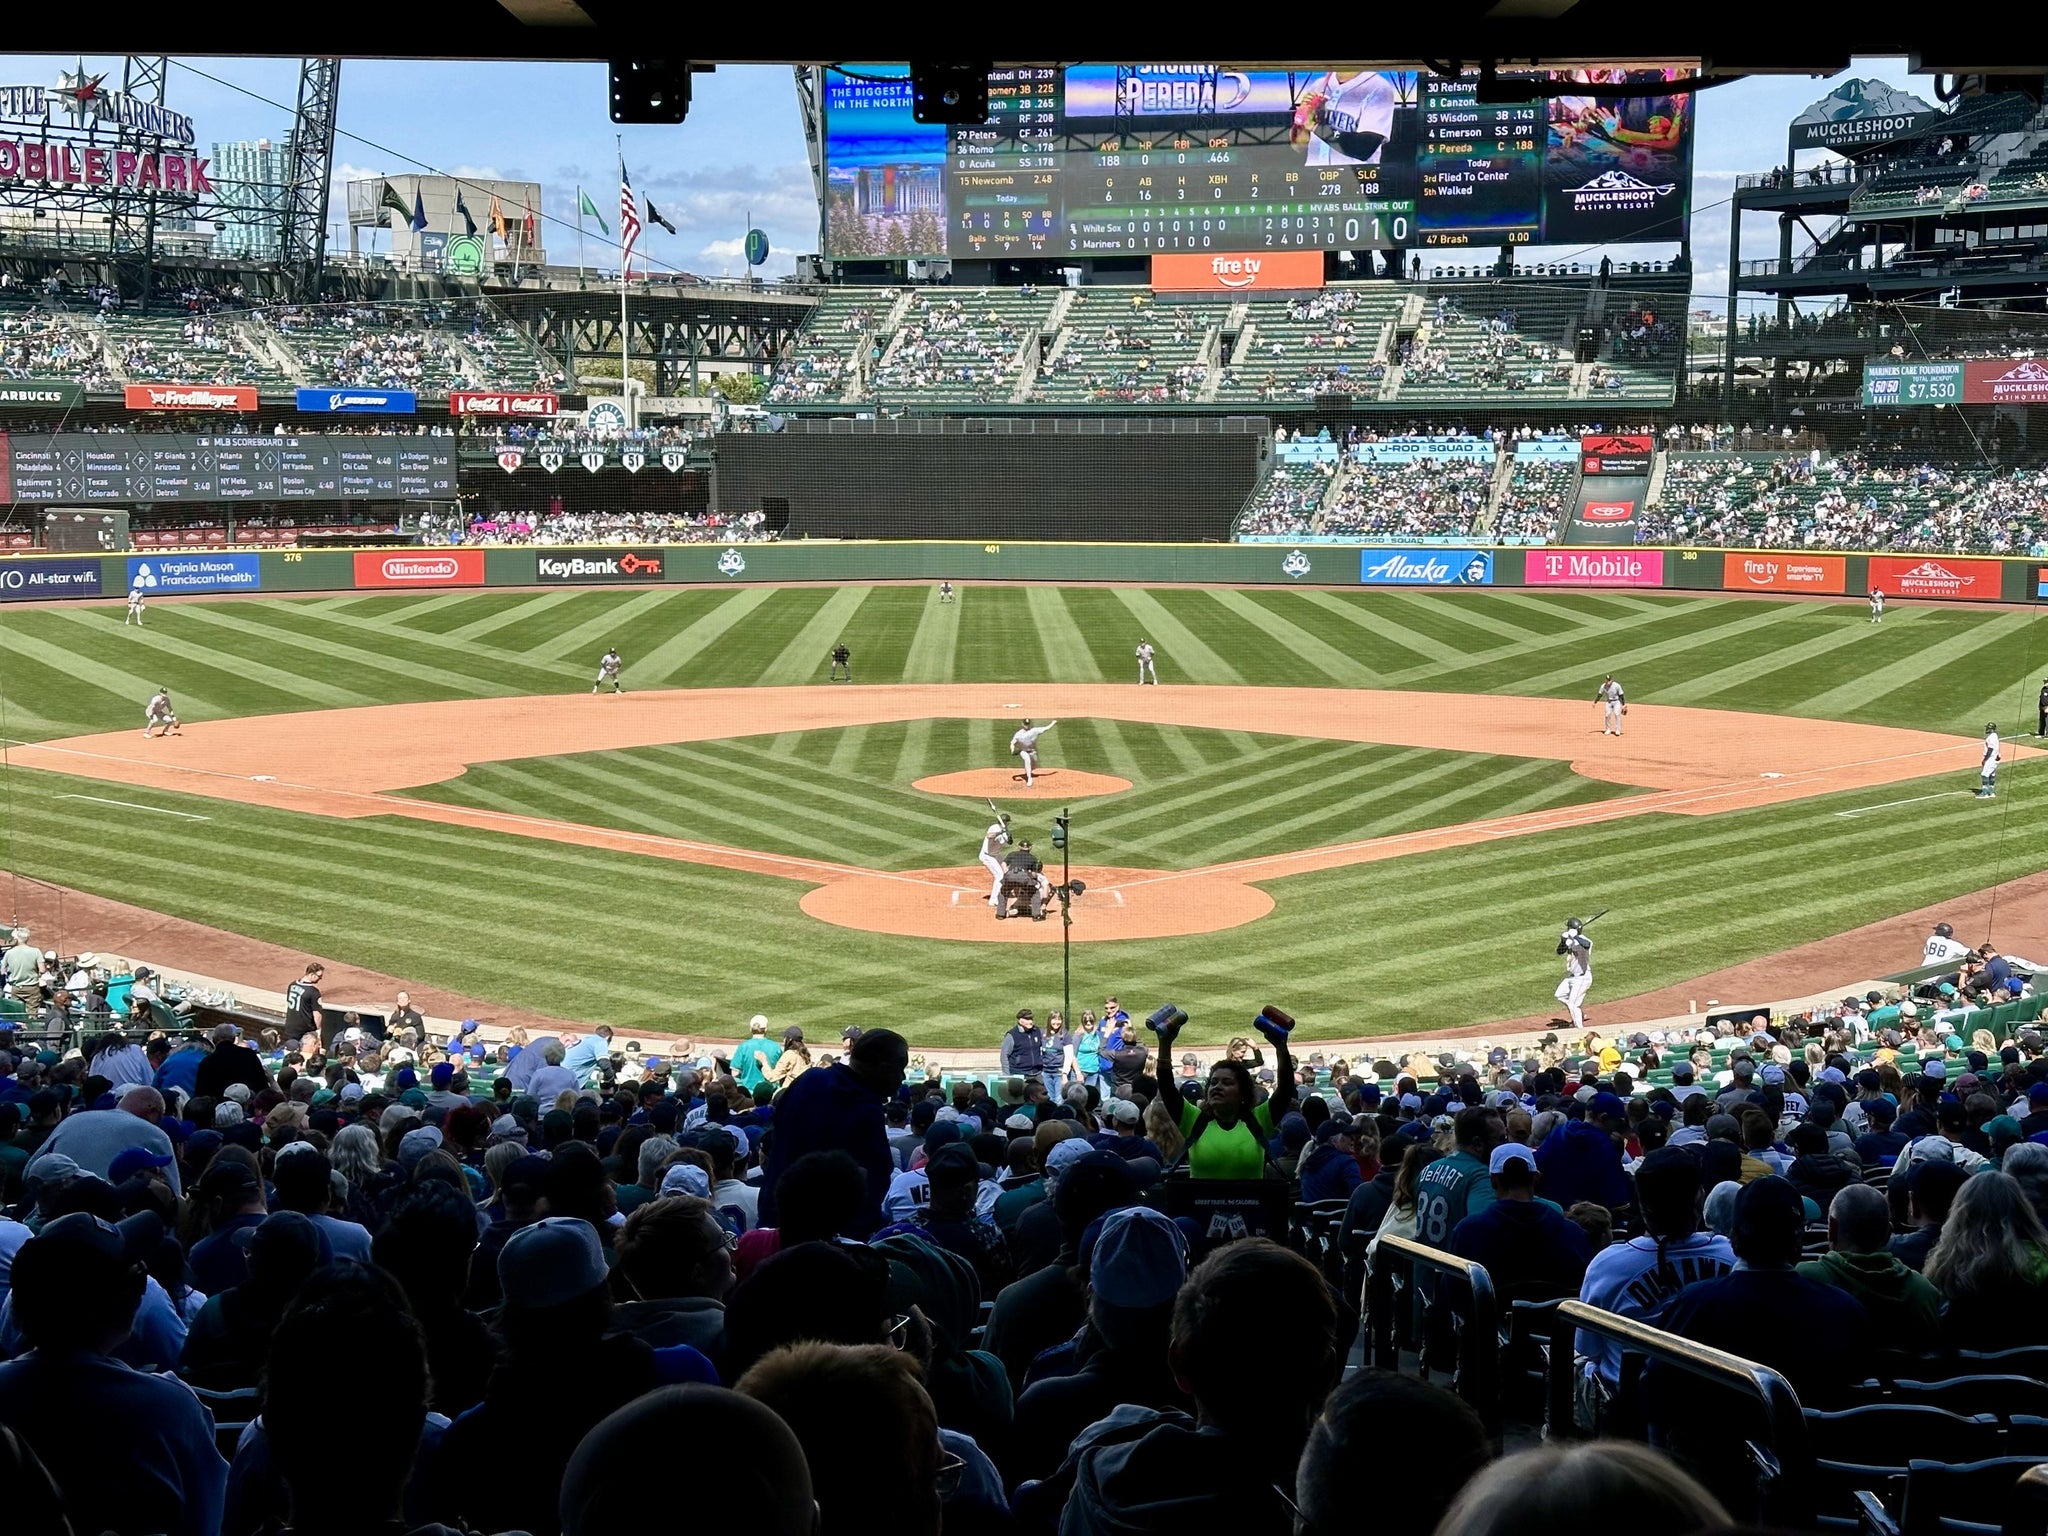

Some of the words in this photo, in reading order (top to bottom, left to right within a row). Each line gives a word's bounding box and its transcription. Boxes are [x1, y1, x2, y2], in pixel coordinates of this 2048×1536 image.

[1034, 70, 1054, 80] .239
[832, 88, 852, 98] THE
[854, 86, 902, 97] BIGGEST
[904, 86, 913, 95] &
[1034, 84, 1054, 94] .225
[1126, 77, 1216, 112] PEREDA
[1428, 84, 1438, 93] 30
[834, 100, 846, 110] IN
[849, 99, 869, 109] THE
[872, 97, 914, 108] NORTH
[1034, 99, 1054, 108] .265
[1440, 98, 1480, 107] Canzon
[100, 88, 195, 145] MARINERS
[1034, 114, 1054, 123] .208
[1426, 114, 1438, 124] 35
[1440, 112, 1478, 122] Wisdom
[1496, 110, 1508, 120] 3B
[1513, 110, 1534, 120] .143
[1440, 128, 1482, 138] Emerson
[1494, 126, 1508, 136] SS
[1512, 125, 1532, 135] .091
[1806, 116, 1916, 138] MUCKLESHOOT
[969, 130, 998, 140] Peters
[1034, 128, 1054, 138] .261
[1826, 136, 1861, 145] INDIAN
[1865, 131, 1894, 141] TRIBE
[969, 144, 994, 154] Romo
[1034, 143, 1054, 152] .178
[1100, 142, 1120, 152] AVG
[1174, 140, 1190, 149] RBI
[1208, 138, 1228, 148] OPS
[1440, 144, 1472, 153] Pereda
[1512, 140, 1534, 150] .188
[969, 160, 996, 168] Acuña
[1034, 158, 1054, 167] .178
[1098, 155, 1120, 166] .188
[1208, 152, 1230, 163] .466
[1467, 159, 1492, 168] Today
[0, 140, 108, 186] OBILE
[115, 150, 214, 194] PARK
[972, 175, 1014, 186] Newcomb
[1034, 174, 1053, 184] 2.48
[1320, 172, 1340, 180] OBP
[1357, 170, 1377, 180] SLG
[1424, 174, 1437, 183] 3rd
[1438, 172, 1462, 182] Flied
[1463, 172, 1476, 182] To
[1477, 172, 1510, 180] Center
[1318, 184, 1342, 196] .278
[1356, 183, 1380, 195] .188
[1424, 188, 1436, 196] 5th
[1438, 186, 1473, 196] Walked
[1574, 191, 1656, 204] MUCKLESHOOT
[1342, 202, 1363, 211] BALL
[1364, 202, 1389, 210] STRIKE
[1392, 202, 1408, 210] OUT
[1574, 203, 1612, 211] CASINO
[1616, 202, 1655, 210] RESORT
[1082, 224, 1105, 233] White
[1106, 224, 1122, 233] Sox
[1346, 218, 1358, 241] 0
[1370, 218, 1379, 240] 1
[1394, 216, 1407, 240] 0
[1082, 239, 1120, 248] Mariners
[1426, 235, 1438, 244] 47
[1440, 234, 1468, 244] Brash
[1508, 232, 1530, 242] 0.00
[1211, 258, 1242, 274] fire
[1244, 257, 1262, 274] tv
[1868, 367, 1900, 376] MARINERS
[1901, 366, 1918, 375] CARE
[1919, 366, 1960, 374] FOUNDATION
[0, 390, 62, 402] ARBUCKS
[1908, 384, 1956, 399] $7,530
[1873, 395, 1900, 404] RAFFLE
[214, 438, 231, 446] MLB
[232, 438, 282, 446] SCOREBOARD
[1379, 443, 1420, 454] J-ROD
[1428, 443, 1474, 454] SQUAD
[86, 452, 115, 460] Houston
[154, 452, 164, 460] SF
[164, 452, 186, 460] Giants
[220, 452, 243, 460] Atlanta
[502, 454, 517, 468] 42
[546, 453, 559, 466] 24
[588, 454, 598, 466] 11
[628, 453, 640, 466] 51
[668, 452, 680, 466] 51
[88, 478, 108, 486] Texas
[155, 478, 188, 486] Cleveland
[282, 477, 305, 485] Boston
[18, 490, 40, 499] Tampa
[42, 490, 54, 499] Bay
[1574, 519, 1636, 528] TOYOTA
[1390, 537, 1424, 545] SQUAD
[984, 545, 1000, 554] 401
[284, 553, 302, 562] 376
[722, 554, 740, 566] 50
[1288, 556, 1305, 567] 50
[1682, 552, 1698, 560] 380
[160, 563, 198, 576] Virginia
[200, 562, 234, 572] Mason
[388, 562, 452, 576] Nintendo
[539, 558, 619, 578] KeyBank
[1366, 555, 1450, 579] Alaska
[1568, 556, 1642, 578] Mobile
[1744, 560, 1764, 574] fire
[1766, 562, 1779, 574] tv
[1786, 564, 1824, 574] Experience
[0, 570, 24, 589] ro
[28, 572, 70, 584] All-star
[74, 570, 97, 583] wifi.
[160, 574, 215, 586] Franciscan
[1786, 574, 1814, 582] smarter
[1814, 572, 1824, 582] TV
[1901, 578, 1960, 589] MUCKLESHOOT
[1928, 942, 1948, 958] 88
[288, 992, 301, 1012] 51
[1420, 1164, 1464, 1190] DeHART
